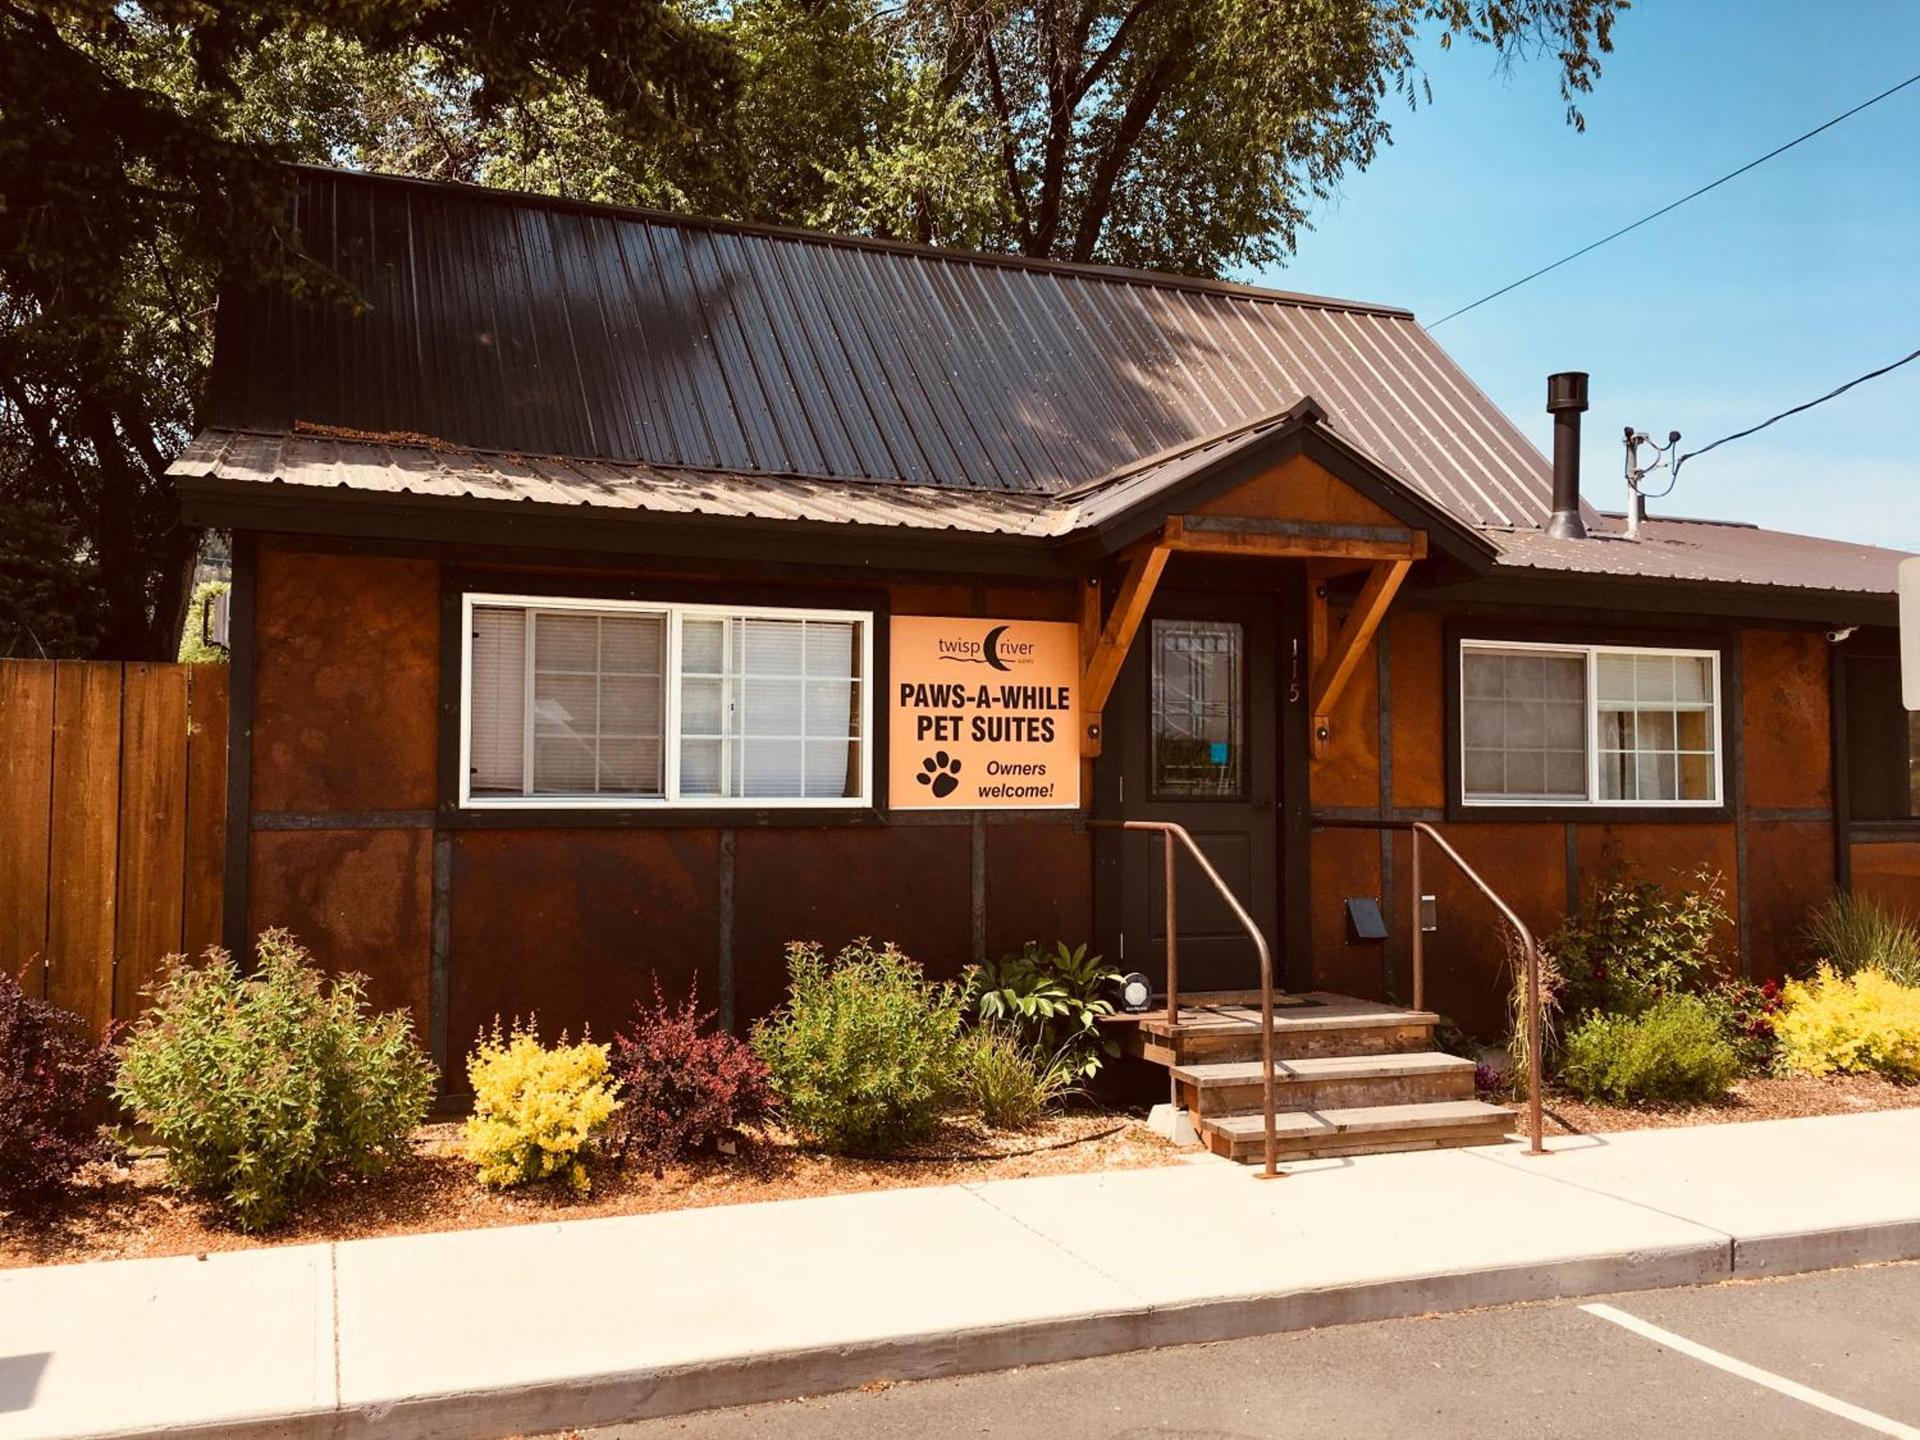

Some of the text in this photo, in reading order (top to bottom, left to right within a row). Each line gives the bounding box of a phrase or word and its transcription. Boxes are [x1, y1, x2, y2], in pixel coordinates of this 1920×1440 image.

[938, 637, 1034, 656] twisp river
[900, 683, 1070, 710] PAWS-A-WHILE
[917, 715, 1054, 742] PET SUITES
[987, 760, 1046, 776] Owners
[978, 783, 1054, 798] welcome!
